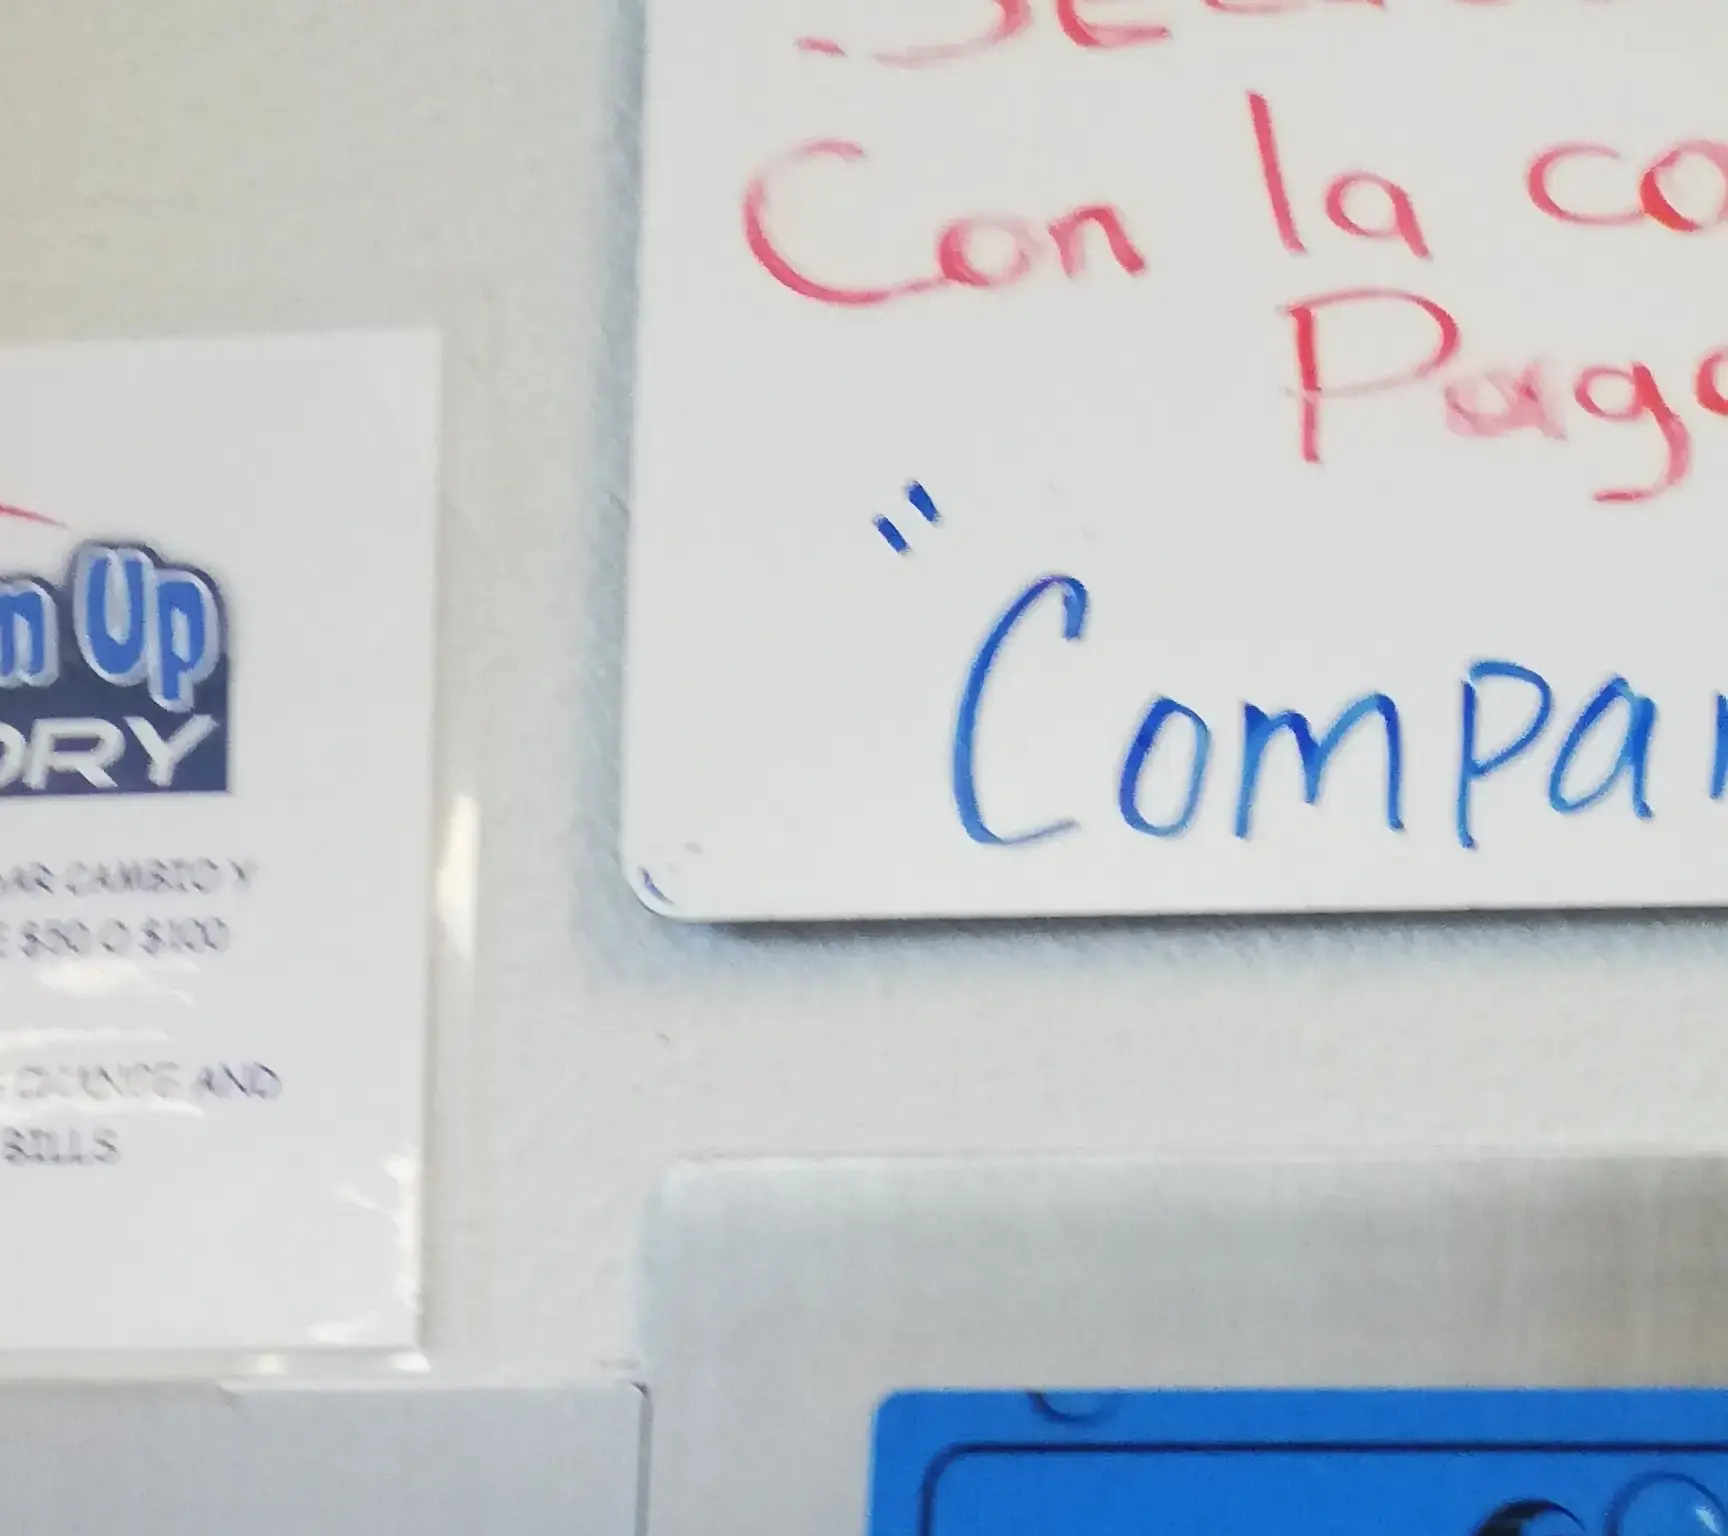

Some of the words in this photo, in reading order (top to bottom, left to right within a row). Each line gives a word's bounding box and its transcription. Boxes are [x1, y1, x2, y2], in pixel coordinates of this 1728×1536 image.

[741, 138, 1149, 308] Con
[1245, 89, 1433, 262] la
[74, 546, 222, 712] Up
[66, 857, 224, 896] CAMBIO
[227, 856, 259, 893] Y
[19, 918, 92, 958] $50
[97, 919, 132, 954] O
[139, 916, 230, 956] $100
[192, 1060, 283, 1100] AND
[0, 1127, 122, 1167] BILLS
